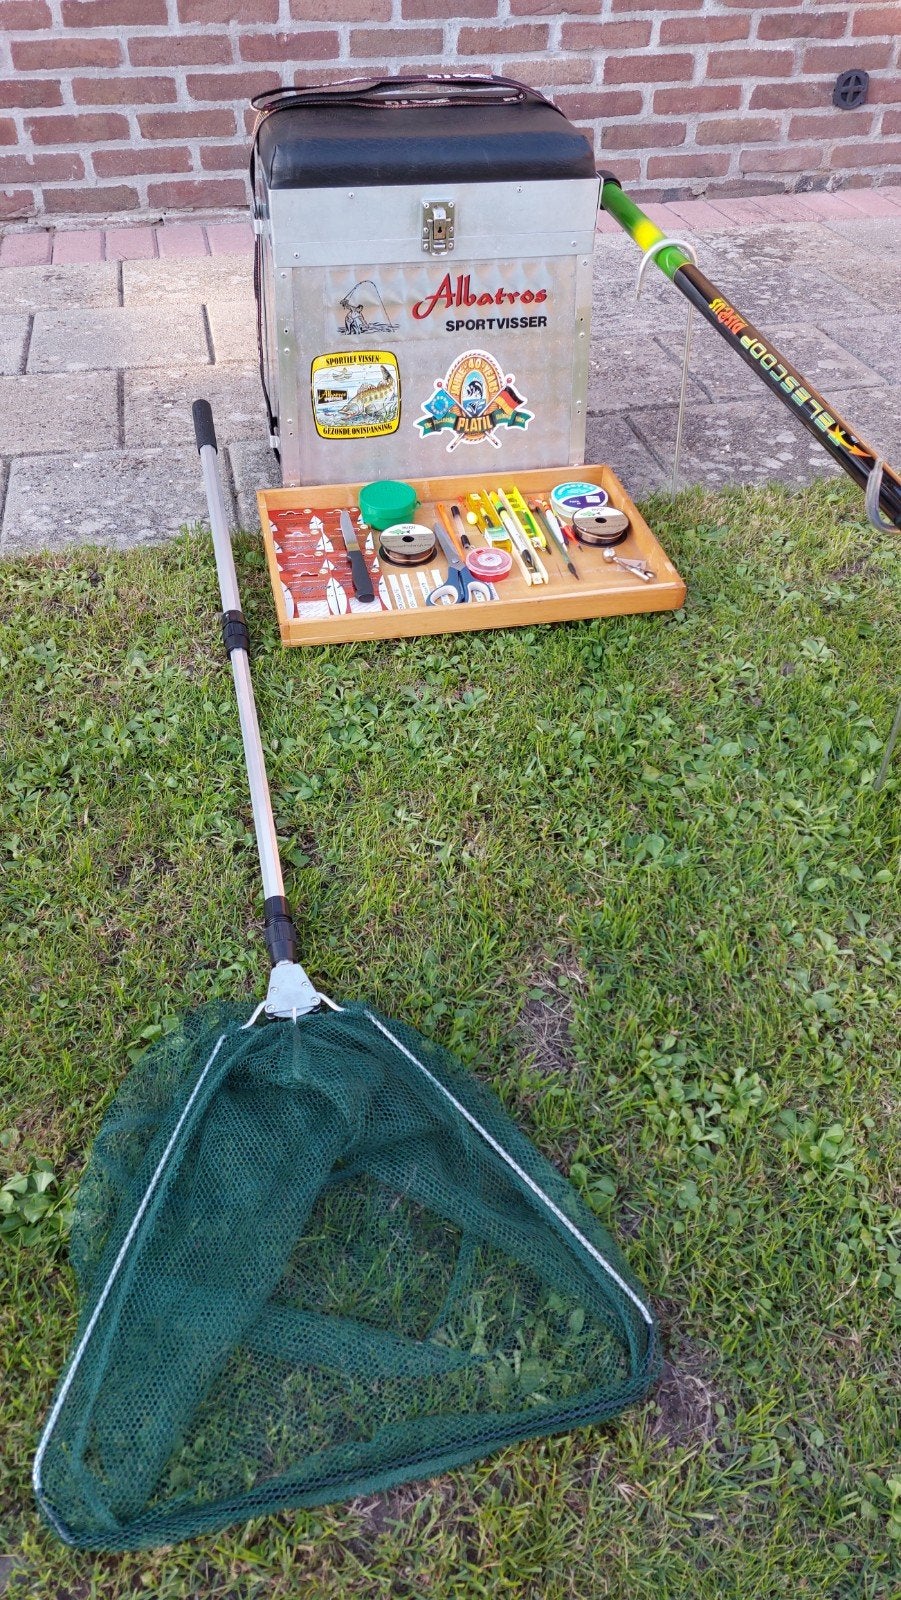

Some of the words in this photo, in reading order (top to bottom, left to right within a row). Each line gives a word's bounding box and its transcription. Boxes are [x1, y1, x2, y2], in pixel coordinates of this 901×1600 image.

[412, 273, 548, 319] Albatros
[445, 316, 547, 332] SPORTVISSER
[325, 355, 357, 365] SPORTIEF
[483, 364, 498, 393] YEARS
[740, 335, 845, 446] TELESCOOP
[323, 426, 351, 435] GEZONDE
[351, 422, 393, 435] ONTSPANNING
[457, 416, 493, 432] PLATIL
